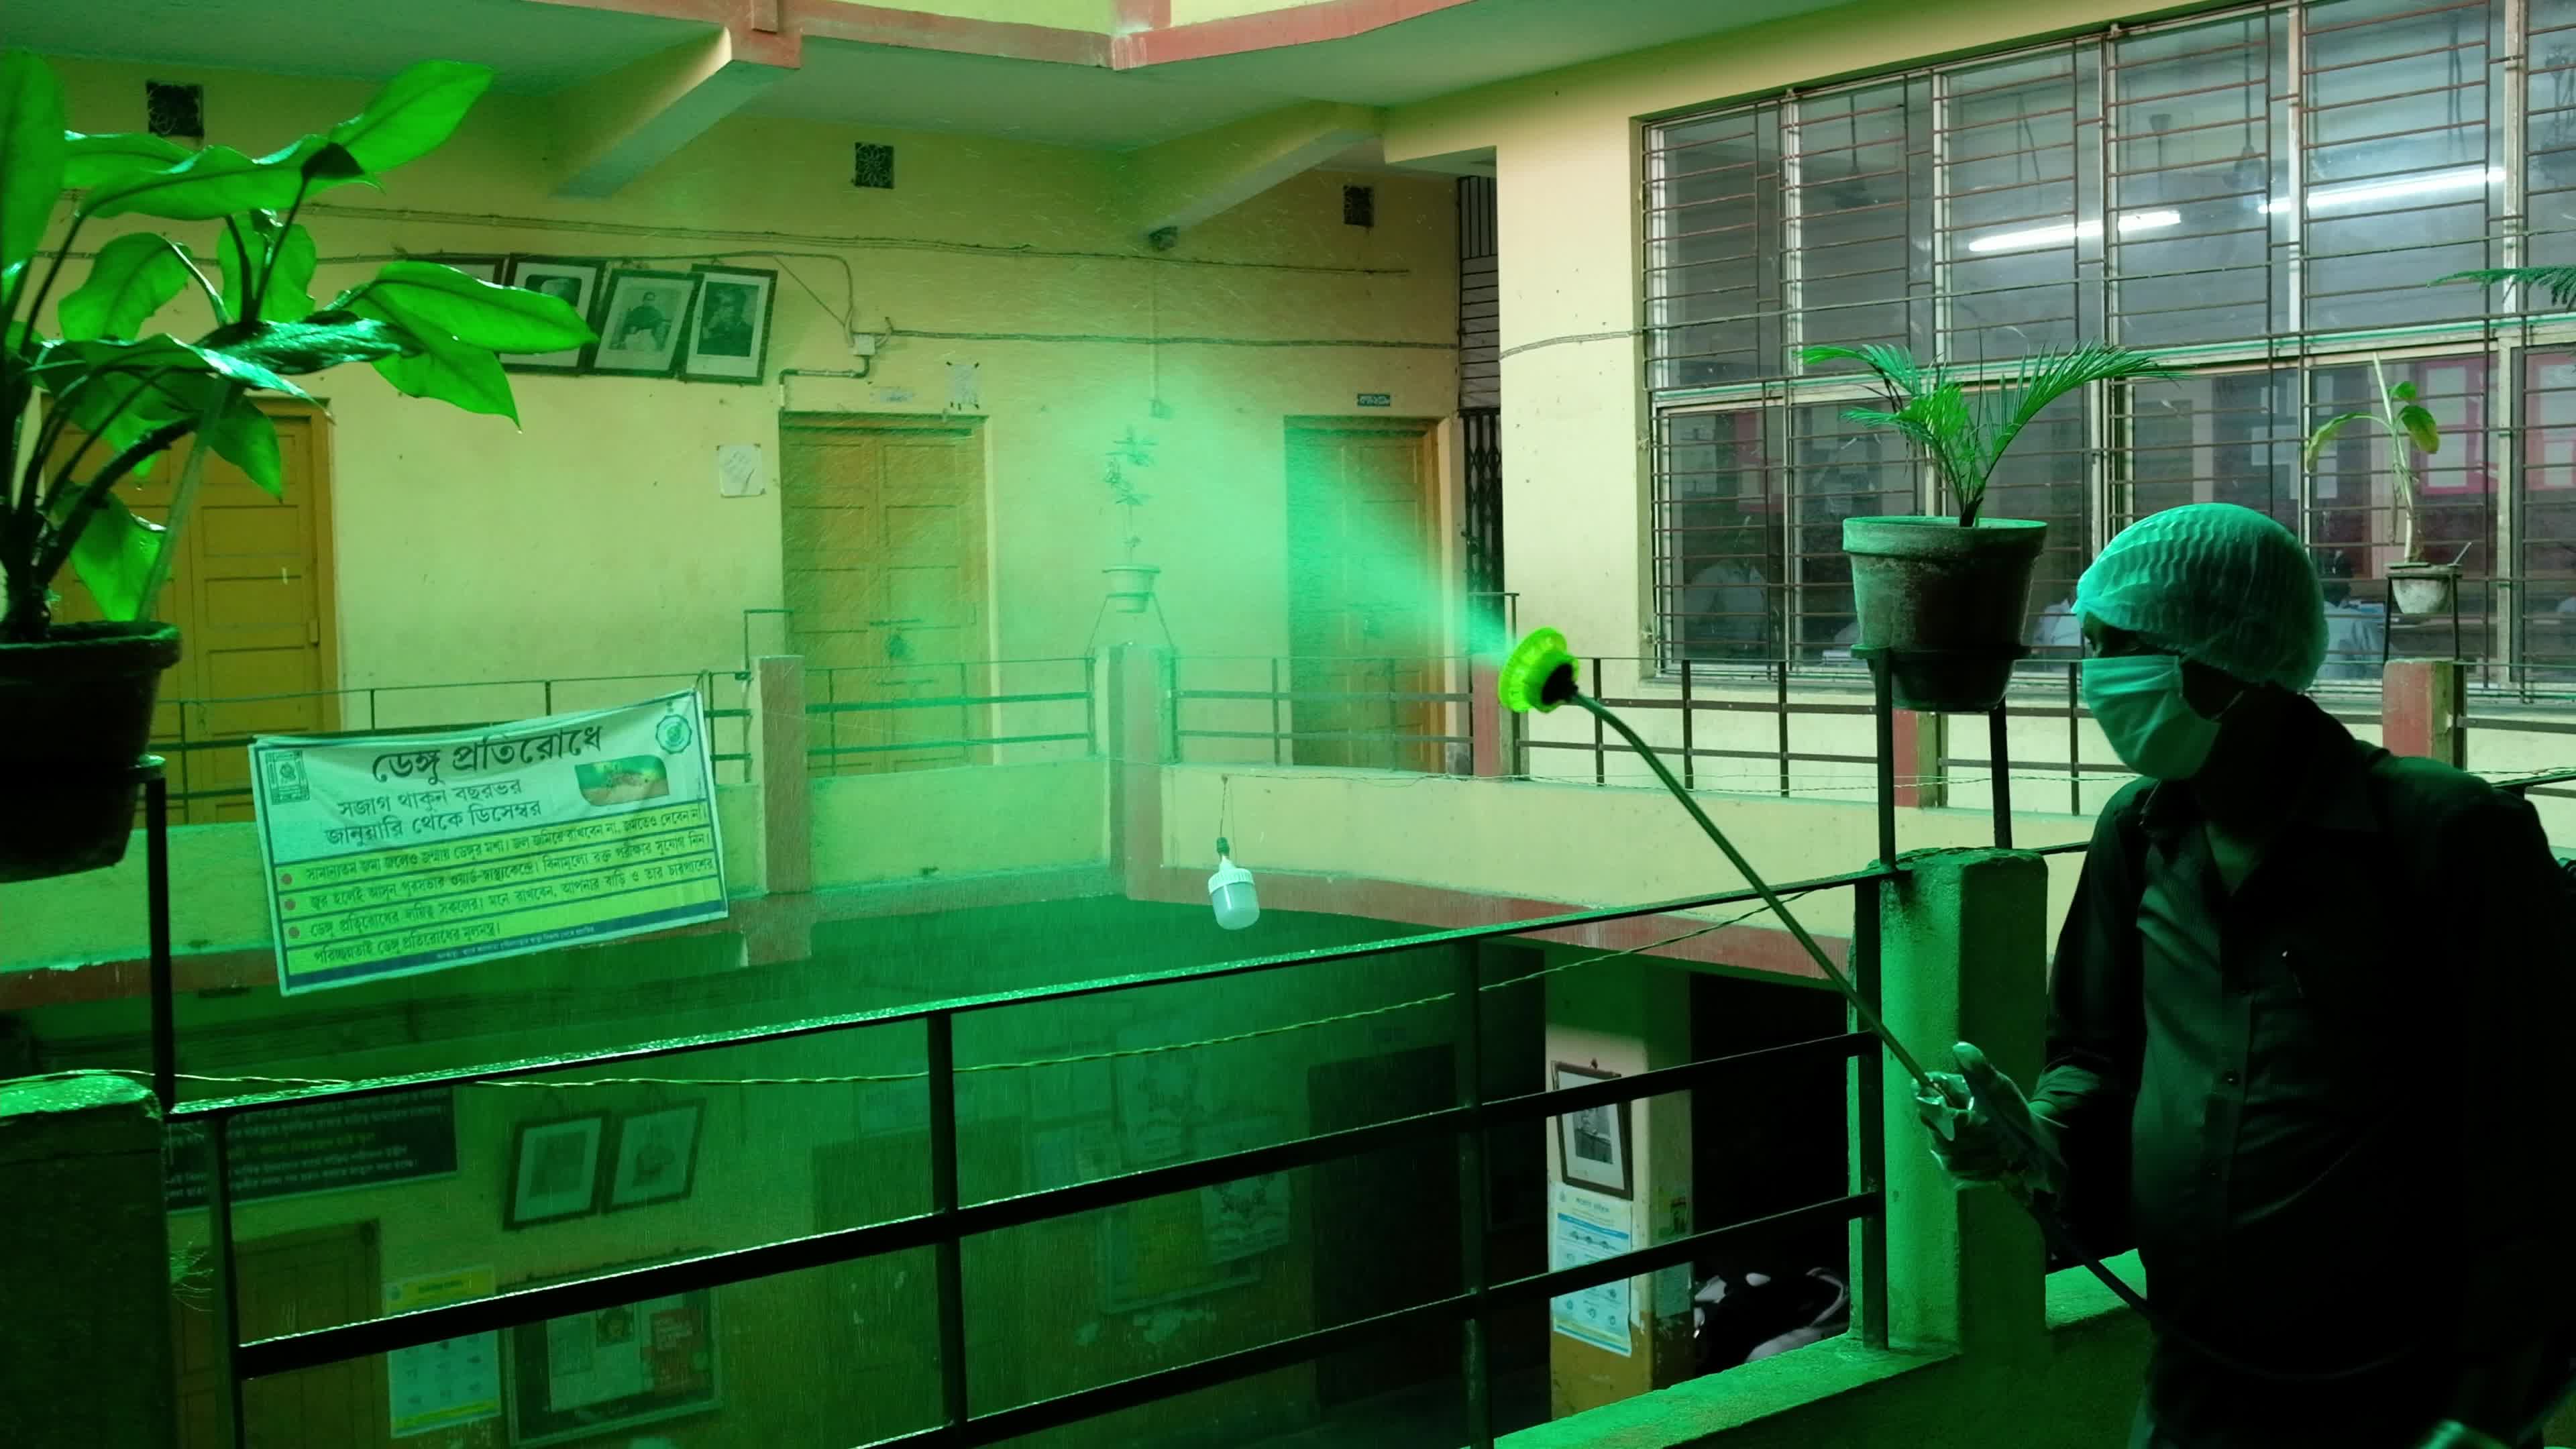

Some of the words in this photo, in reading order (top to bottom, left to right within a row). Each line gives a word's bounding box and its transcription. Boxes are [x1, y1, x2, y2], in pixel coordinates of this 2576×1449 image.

[372, 749, 443, 785] ডেঙ্গু
[452, 725, 603, 772] প্রতিরোধে
[337, 796, 392, 819] সজাগ
[397, 789, 448, 812] থাকুন
[452, 778, 522, 802] বছরভর
[323, 814, 403, 847] জানুয়ারি
[411, 811, 464, 835] থেকে
[470, 800, 542, 827] ডিসেম্বর
[512, 837, 531, 850] জল
[567, 824, 602, 839] রাখবেন
[561, 877, 600, 895] আপনার
[632, 871, 640, 883] ও
[643, 865, 664, 881] তার
[667, 857, 714, 877] চারপাশের
